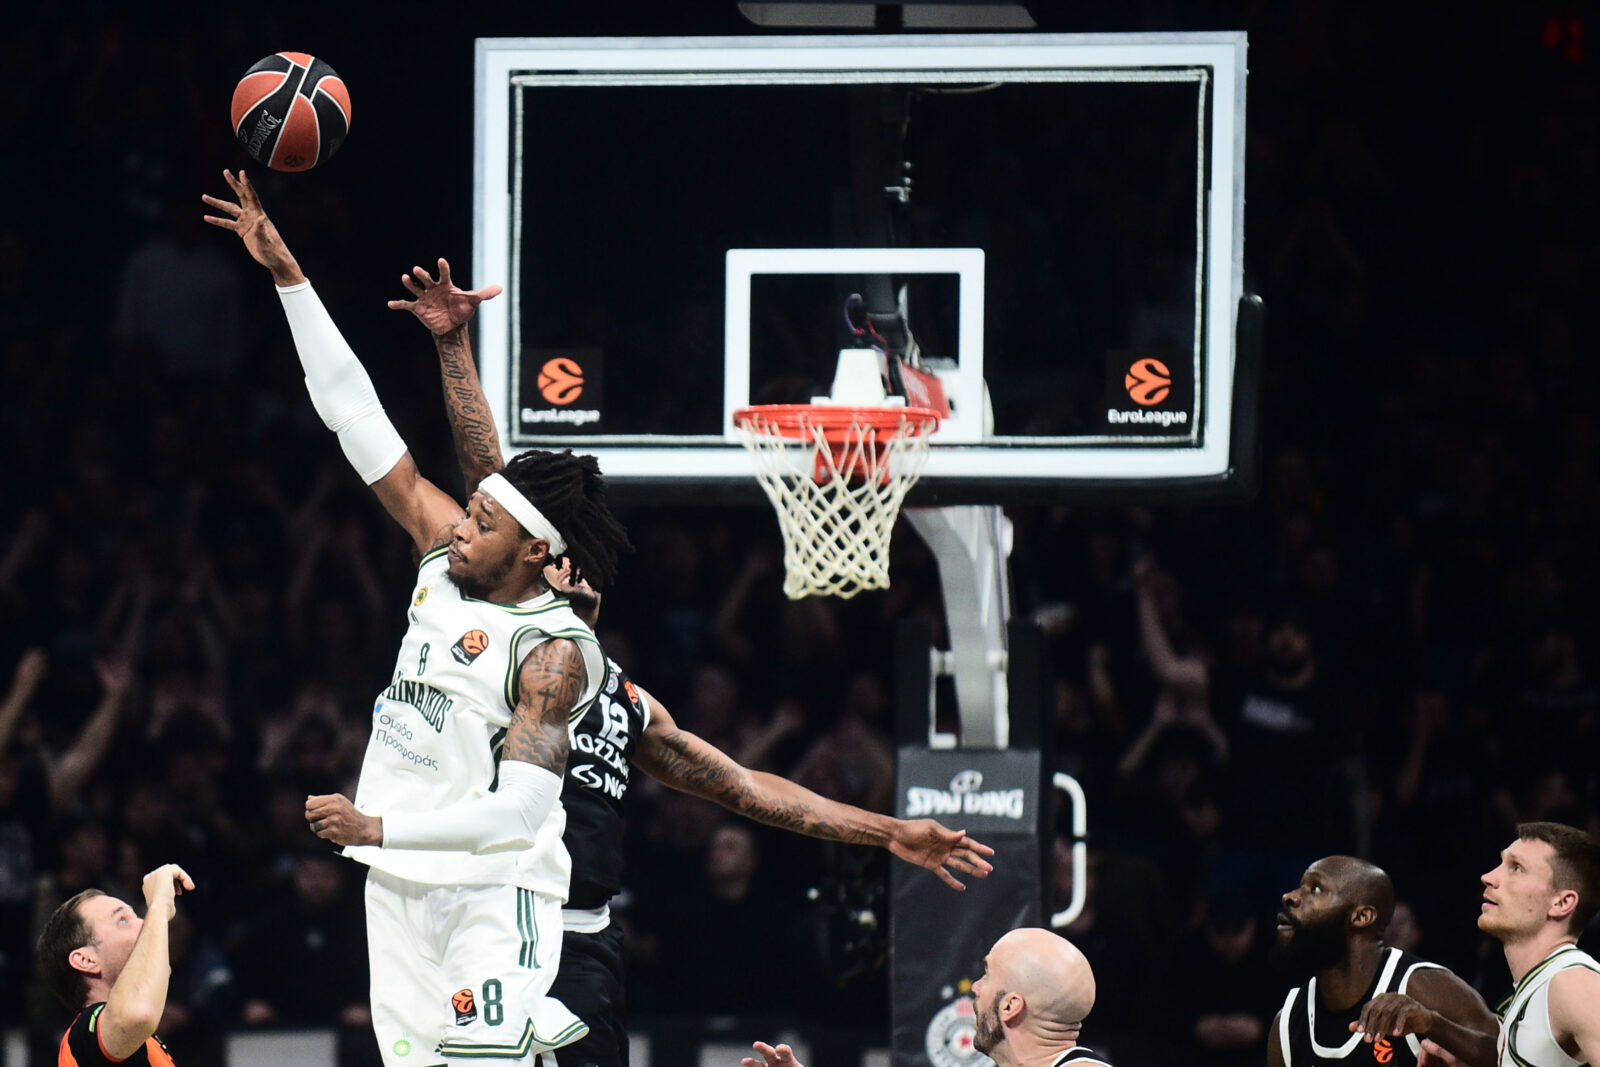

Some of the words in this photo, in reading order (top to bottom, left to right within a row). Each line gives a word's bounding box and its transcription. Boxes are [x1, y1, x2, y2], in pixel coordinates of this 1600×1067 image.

[1107, 408, 1187, 427] EuroLeague
[417, 642, 431, 676] 8
[598, 692, 629, 751] 12
[482, 978, 504, 1026] 8
